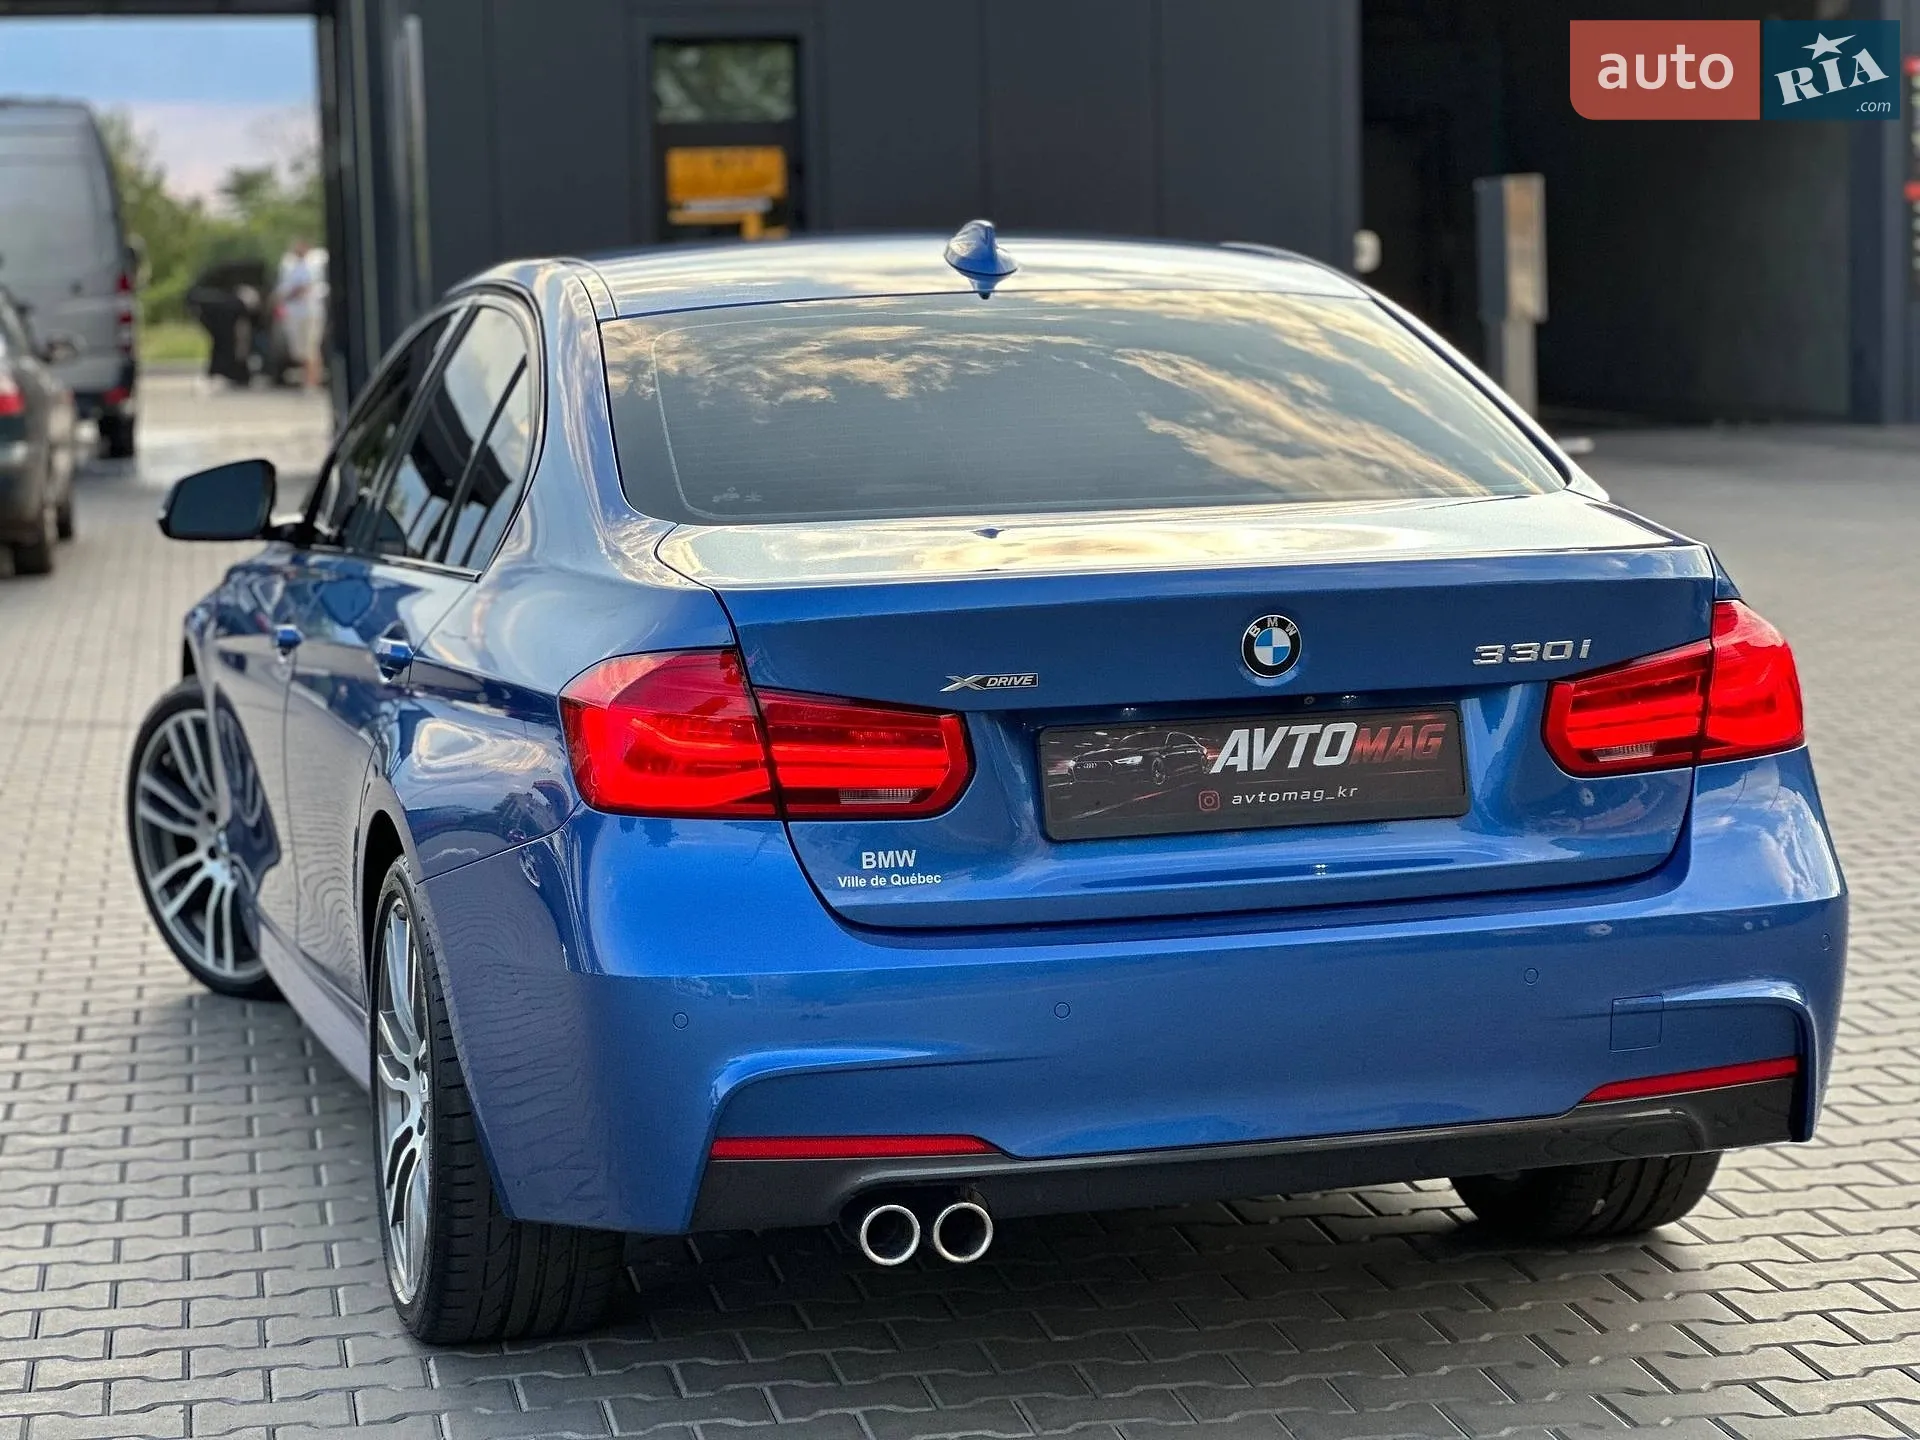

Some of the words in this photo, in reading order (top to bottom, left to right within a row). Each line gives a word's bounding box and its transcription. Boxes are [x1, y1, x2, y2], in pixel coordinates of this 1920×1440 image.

[1249, 616, 1297, 638] BMW
[1472, 639, 1591, 665] 330i
[1231, 785, 1358, 805] avtomag_kr
[862, 850, 917, 869] BMW
[837, 875, 867, 888] Ville
[870, 875, 888, 886] de
[890, 872, 942, 886] Québec
